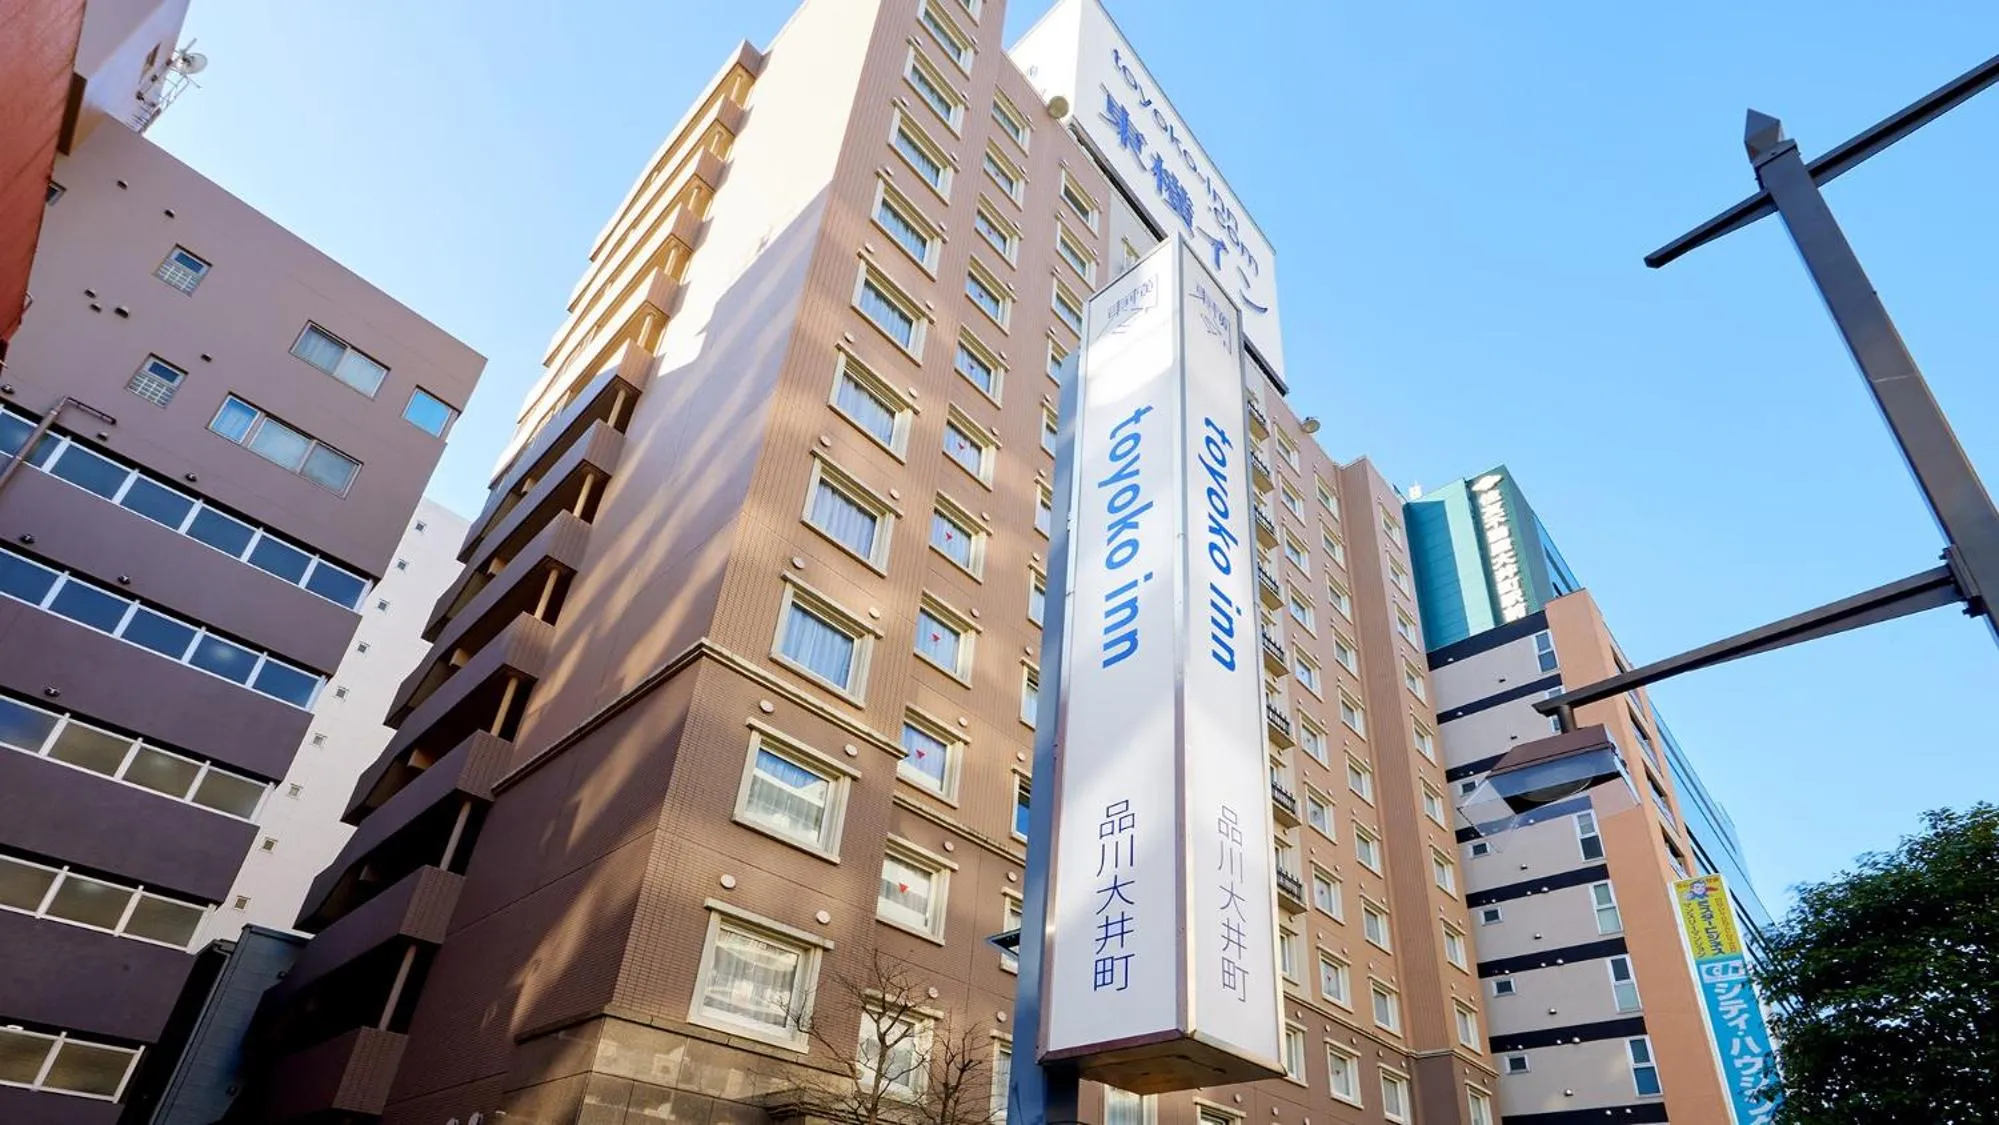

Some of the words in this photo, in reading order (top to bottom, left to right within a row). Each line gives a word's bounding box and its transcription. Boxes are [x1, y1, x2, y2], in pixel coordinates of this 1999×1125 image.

[1098, 81, 1268, 314] 東横イン
[1097, 404, 1154, 571] toyoko
[1198, 416, 1239, 577] toyoko
[1101, 571, 1154, 669] inn
[1209, 581, 1243, 673] inn
[1093, 799, 1136, 992] 品川大井町
[1216, 804, 1250, 1003] 品川大井町
